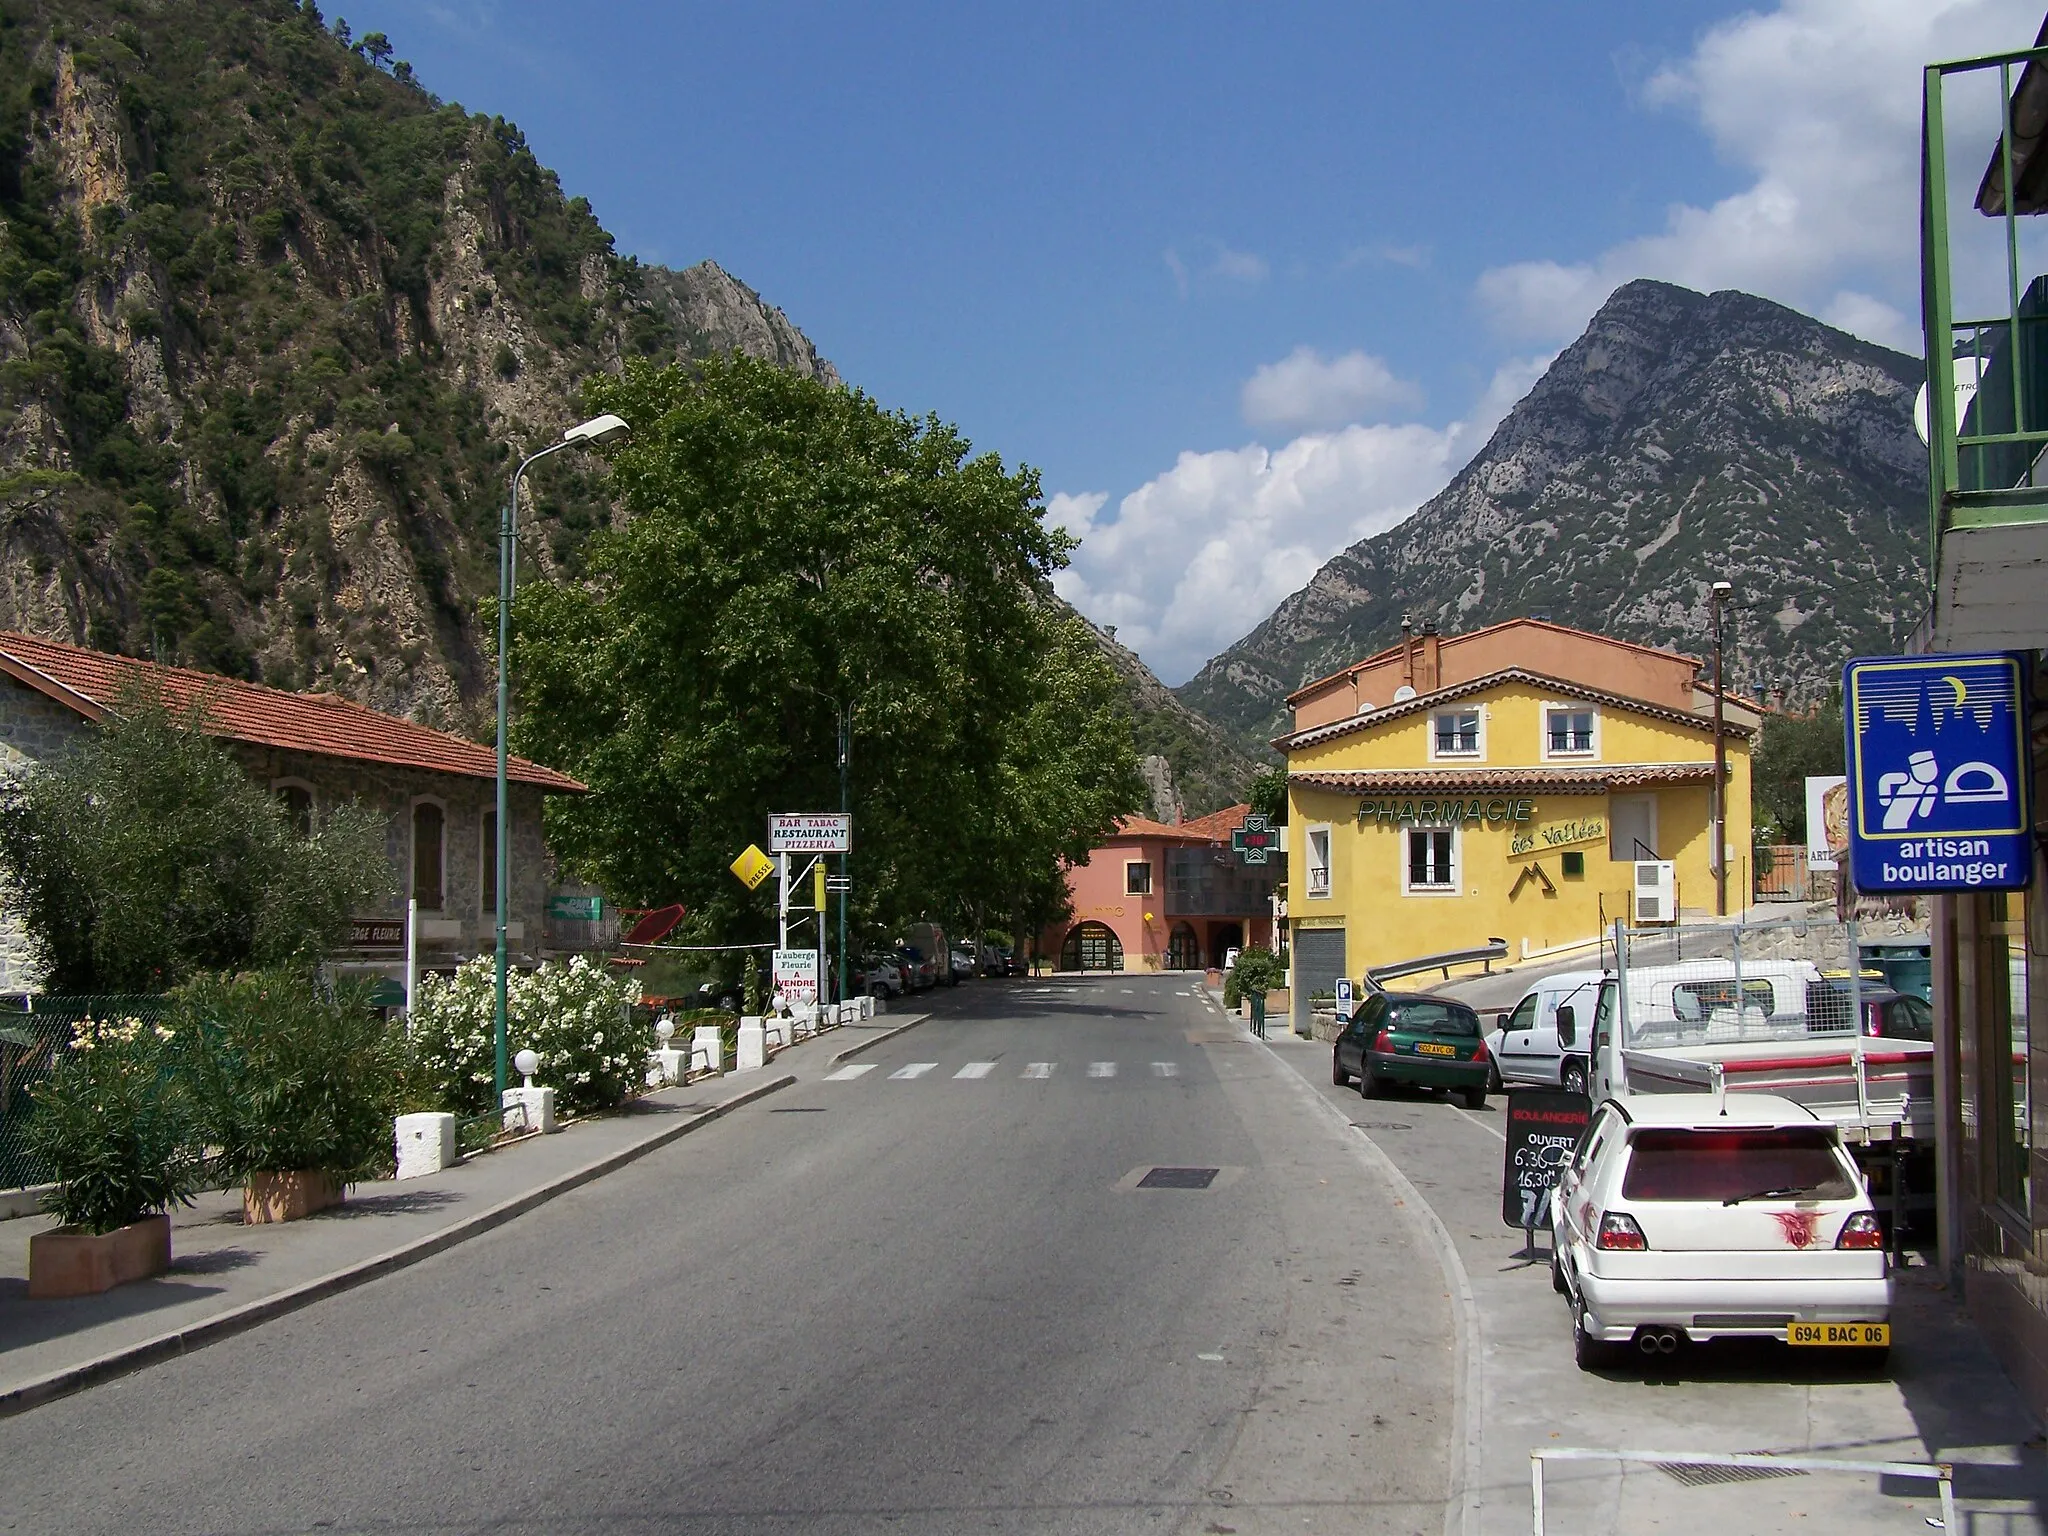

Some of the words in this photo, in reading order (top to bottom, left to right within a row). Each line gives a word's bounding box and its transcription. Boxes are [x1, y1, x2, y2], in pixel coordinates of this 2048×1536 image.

[1357, 799, 1533, 823] PHARMACIE
[779, 819, 801, 827] BAR
[807, 819, 839, 827] TABAC
[773, 829, 846, 838] RESTAURANT
[1541, 818, 1602, 845] Vallées
[785, 840, 836, 849] PIZZERIA
[1900, 838, 1990, 858] artisan
[1810, 850, 1836, 861] ARTI
[748, 863, 771, 887] PRESSE
[1883, 861, 2008, 885] boulanger
[775, 951, 816, 961] L'auberge
[781, 961, 812, 969] Fleurie
[1340, 983, 1349, 998] P
[1528, 1134, 1575, 1148] OUVERT
[1795, 1327, 1821, 1341] 694
[1828, 1327, 1858, 1342] BAC
[1865, 1327, 1882, 1342] 06
